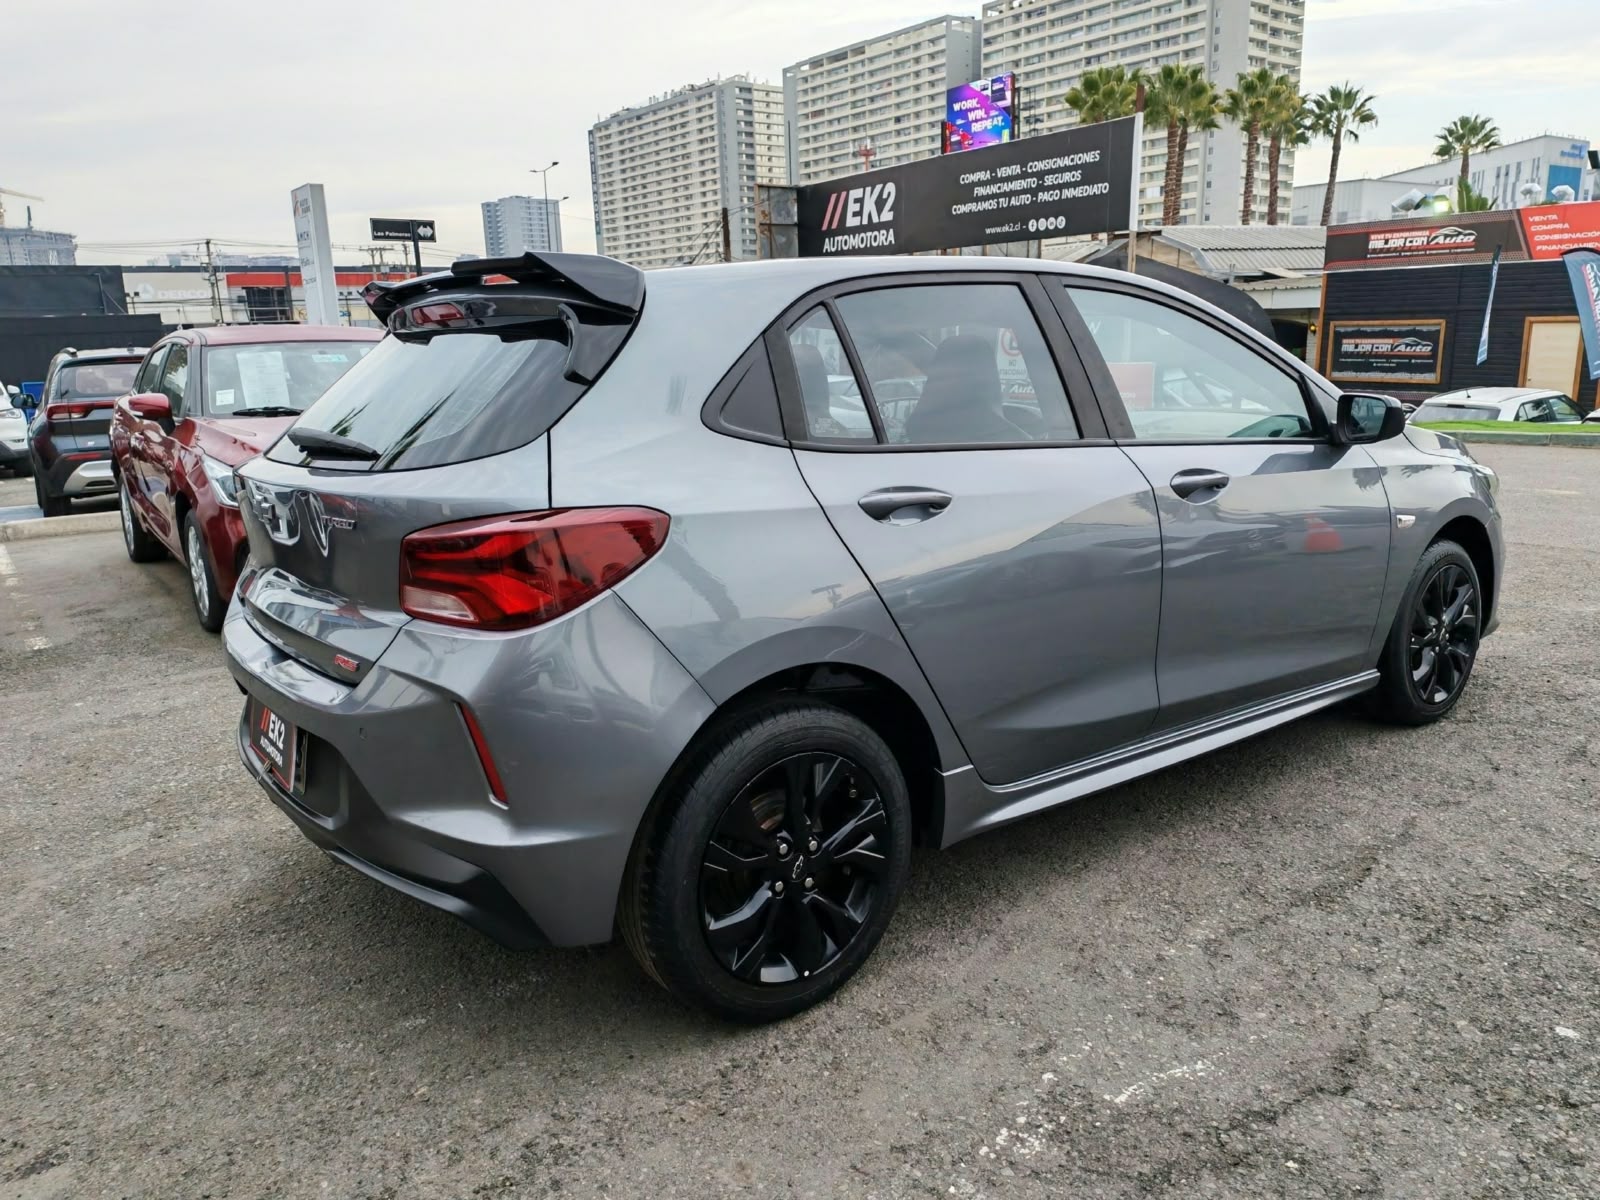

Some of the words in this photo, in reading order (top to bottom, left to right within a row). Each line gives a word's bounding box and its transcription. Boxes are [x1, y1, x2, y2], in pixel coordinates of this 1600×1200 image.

[953, 98, 980, 111] WORK.
[968, 109, 987, 121] WIN.
[971, 116, 1005, 133] REPEAT.
[959, 170, 991, 184] COMPRA
[997, 164, 1021, 178] VENTA
[1027, 150, 1101, 173] CONSIGNACIONES
[973, 178, 1038, 197] FINANCIAMIENTO
[1043, 170, 1082, 186] SEGUROS
[951, 198, 998, 215] COMPRAMOS
[999, 196, 1009, 208] TU
[1010, 194, 1032, 206] AUTO
[1037, 189, 1060, 203] PAGO
[1061, 182, 1109, 199] INMEDIATO
[1529, 214, 1558, 222] VENTA
[985, 221, 1021, 234] www.ek2.cl
[1531, 223, 1570, 231] COMPRA
[822, 228, 895, 253] AUTOMOTORA
[1368, 238, 1405, 249] MEJOR
[1405, 236, 1428, 247] CON
[1430, 234, 1476, 245] Auto
[1341, 344, 1372, 352] MEJOR
[1372, 344, 1391, 352] CON
[1393, 343, 1433, 352] Auto
